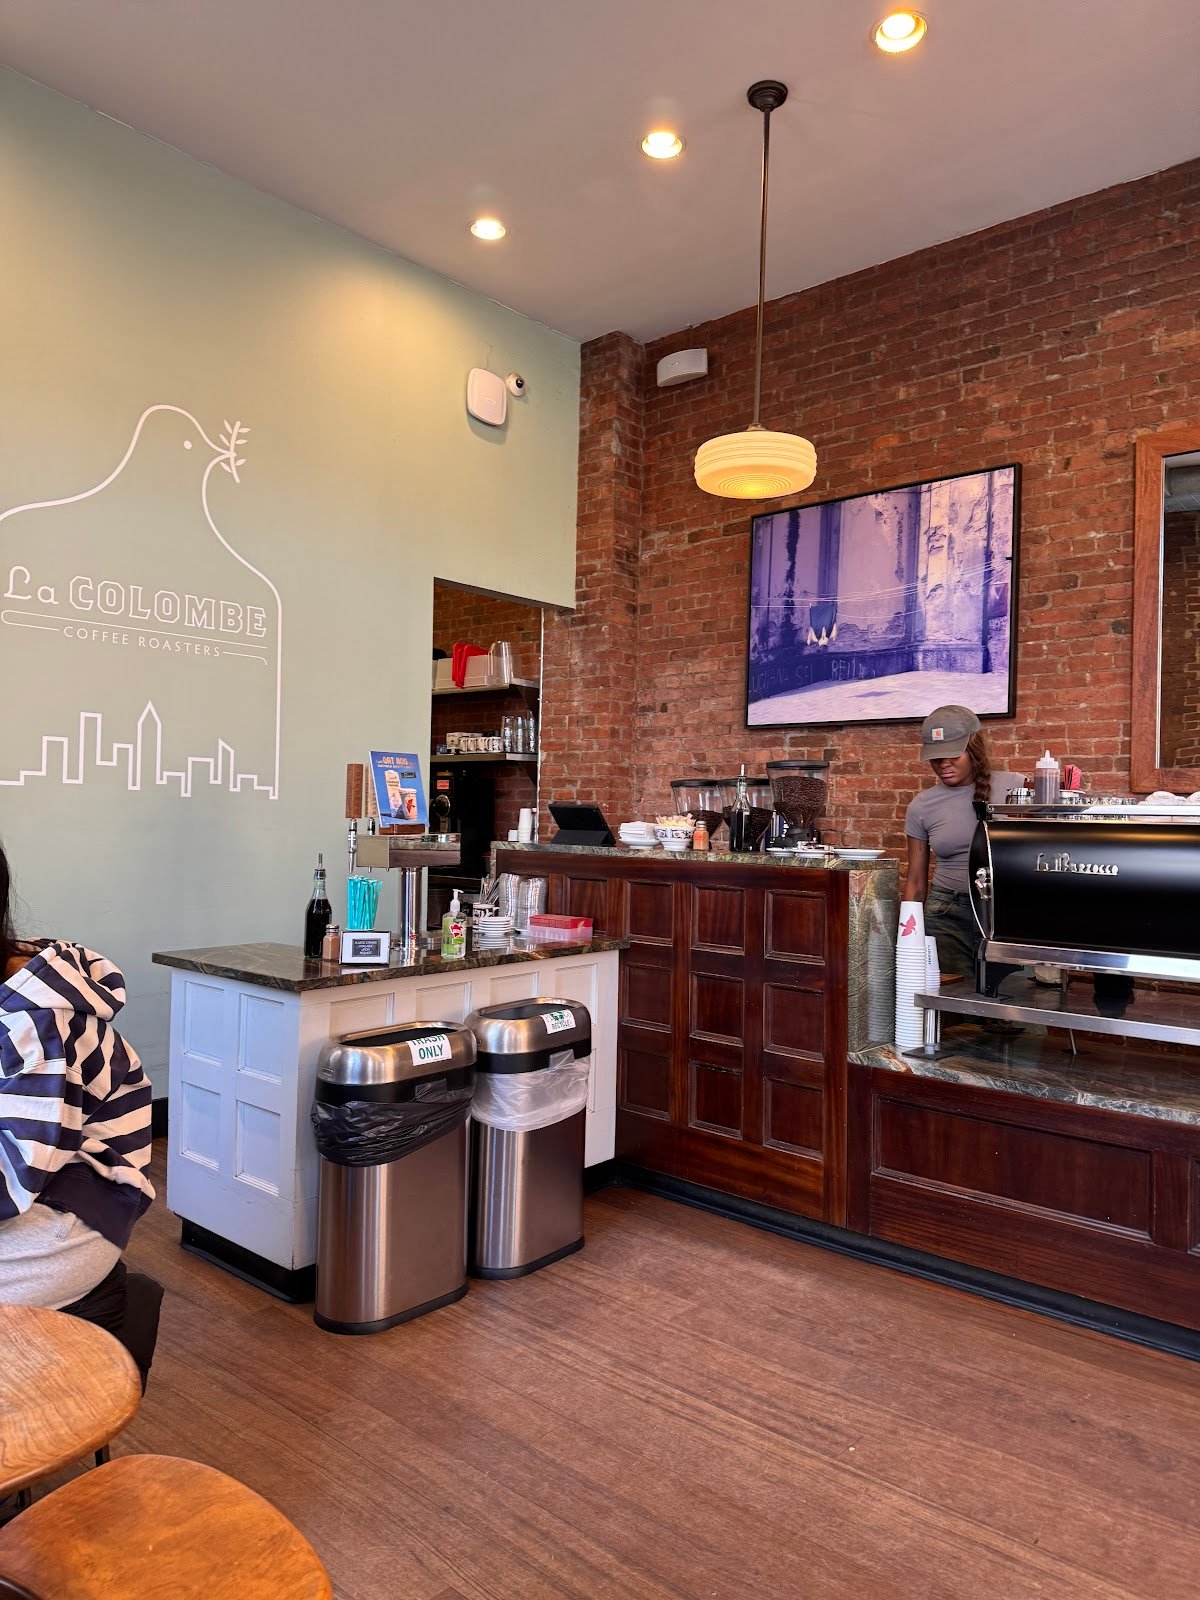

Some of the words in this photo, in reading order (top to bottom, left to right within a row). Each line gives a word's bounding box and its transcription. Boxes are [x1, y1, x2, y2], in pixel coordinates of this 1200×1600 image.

[4, 565, 59, 605] La
[69, 575, 267, 638] COLOMBE
[63, 626, 129, 645] COFFEE
[138, 636, 220, 657] ROASTERS
[418, 1044, 443, 1060] ONLY
